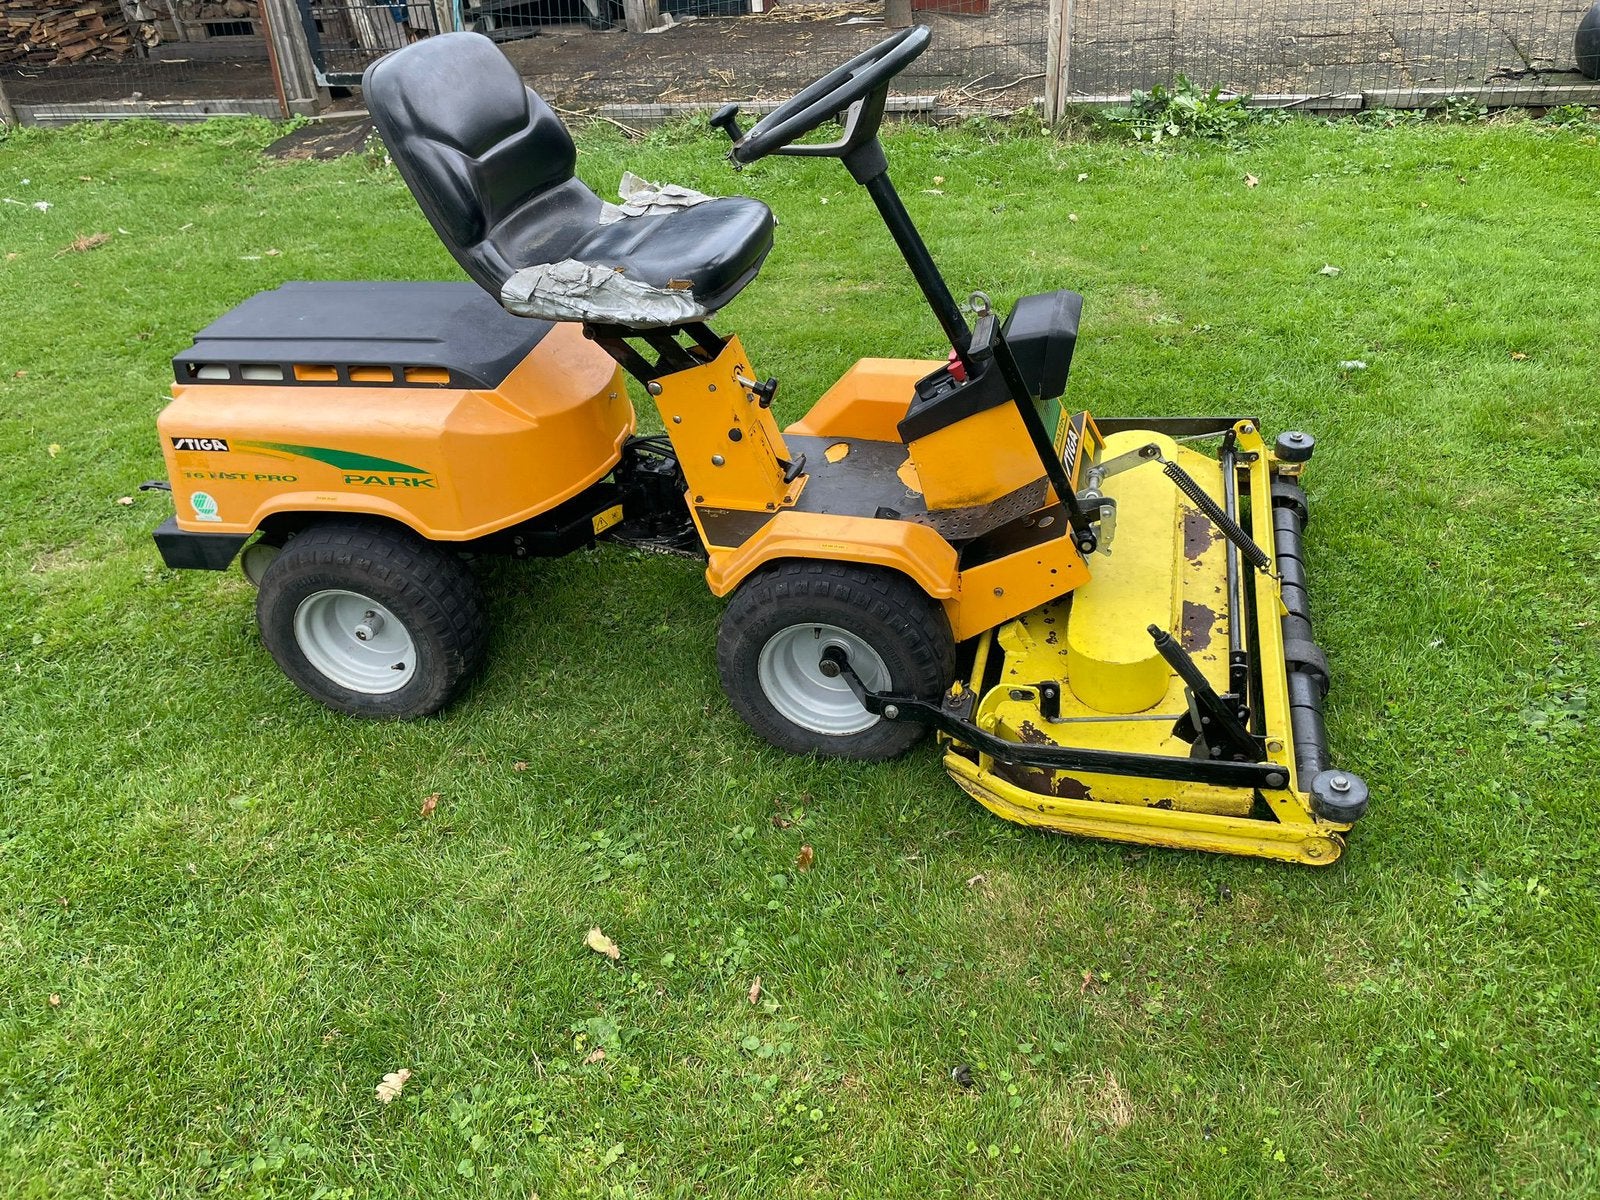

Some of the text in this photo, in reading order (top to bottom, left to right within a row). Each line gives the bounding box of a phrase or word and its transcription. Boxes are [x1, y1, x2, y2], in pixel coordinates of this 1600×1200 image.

[175, 438, 228, 451] STIGA
[1063, 429, 1079, 477] STIGA
[254, 473, 298, 483] PRO
[343, 474, 436, 489] PARK
